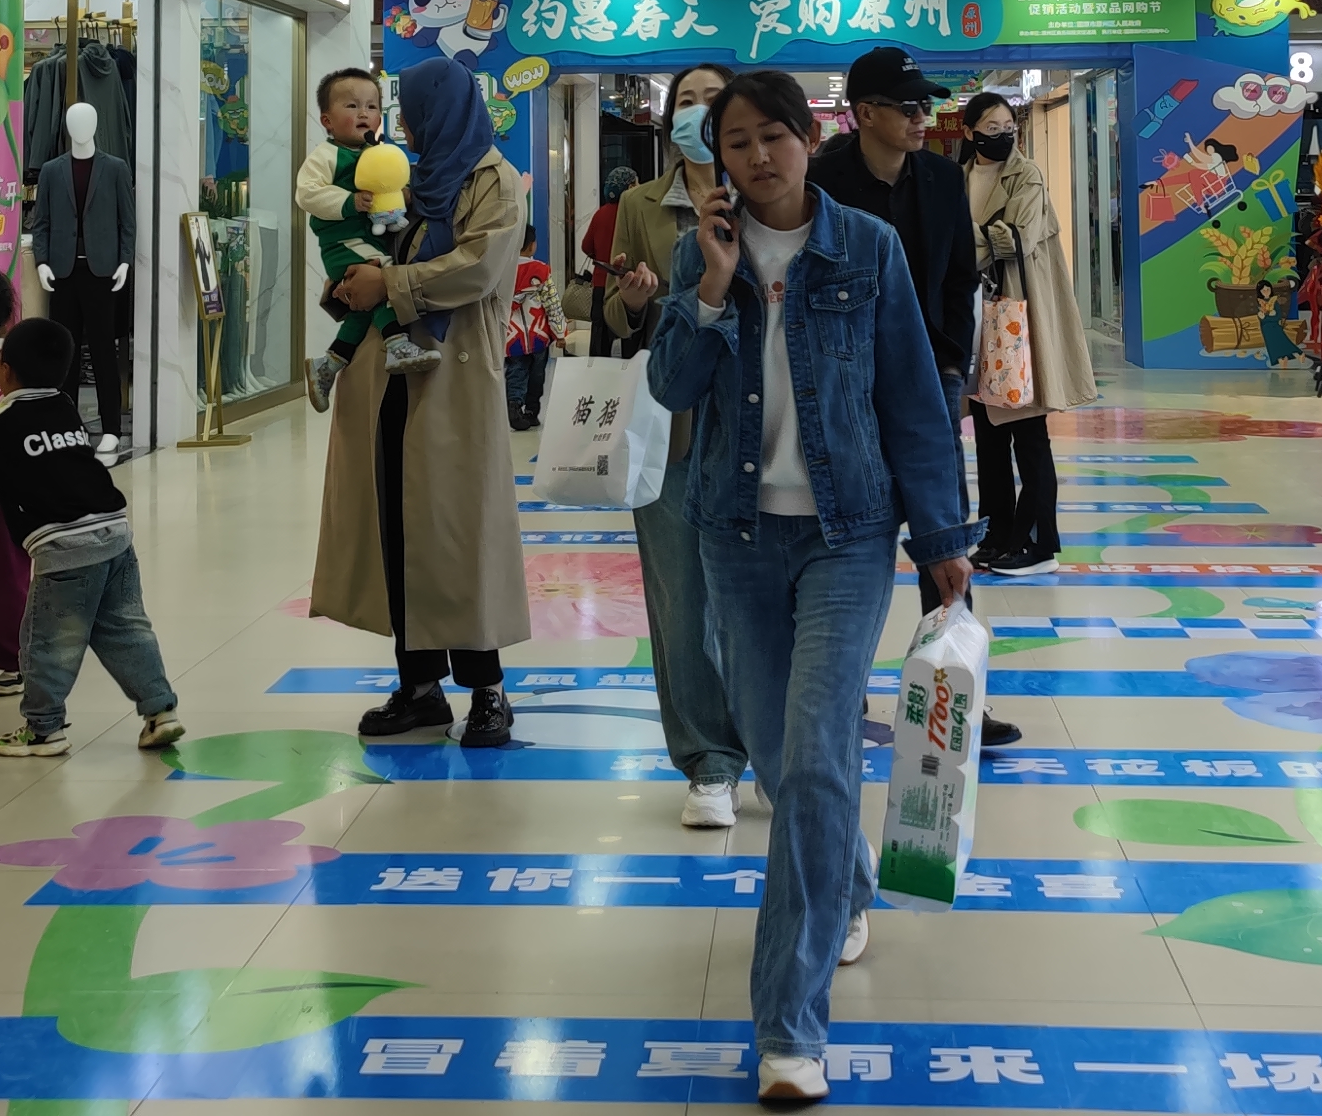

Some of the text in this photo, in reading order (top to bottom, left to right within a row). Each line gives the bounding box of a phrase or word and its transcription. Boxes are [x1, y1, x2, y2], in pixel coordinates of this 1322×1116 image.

[1029, 1, 1162, 16] 促销活动暨双品网购节
[505, 64, 544, 90] WOW
[927, 682, 951, 753] 1700
